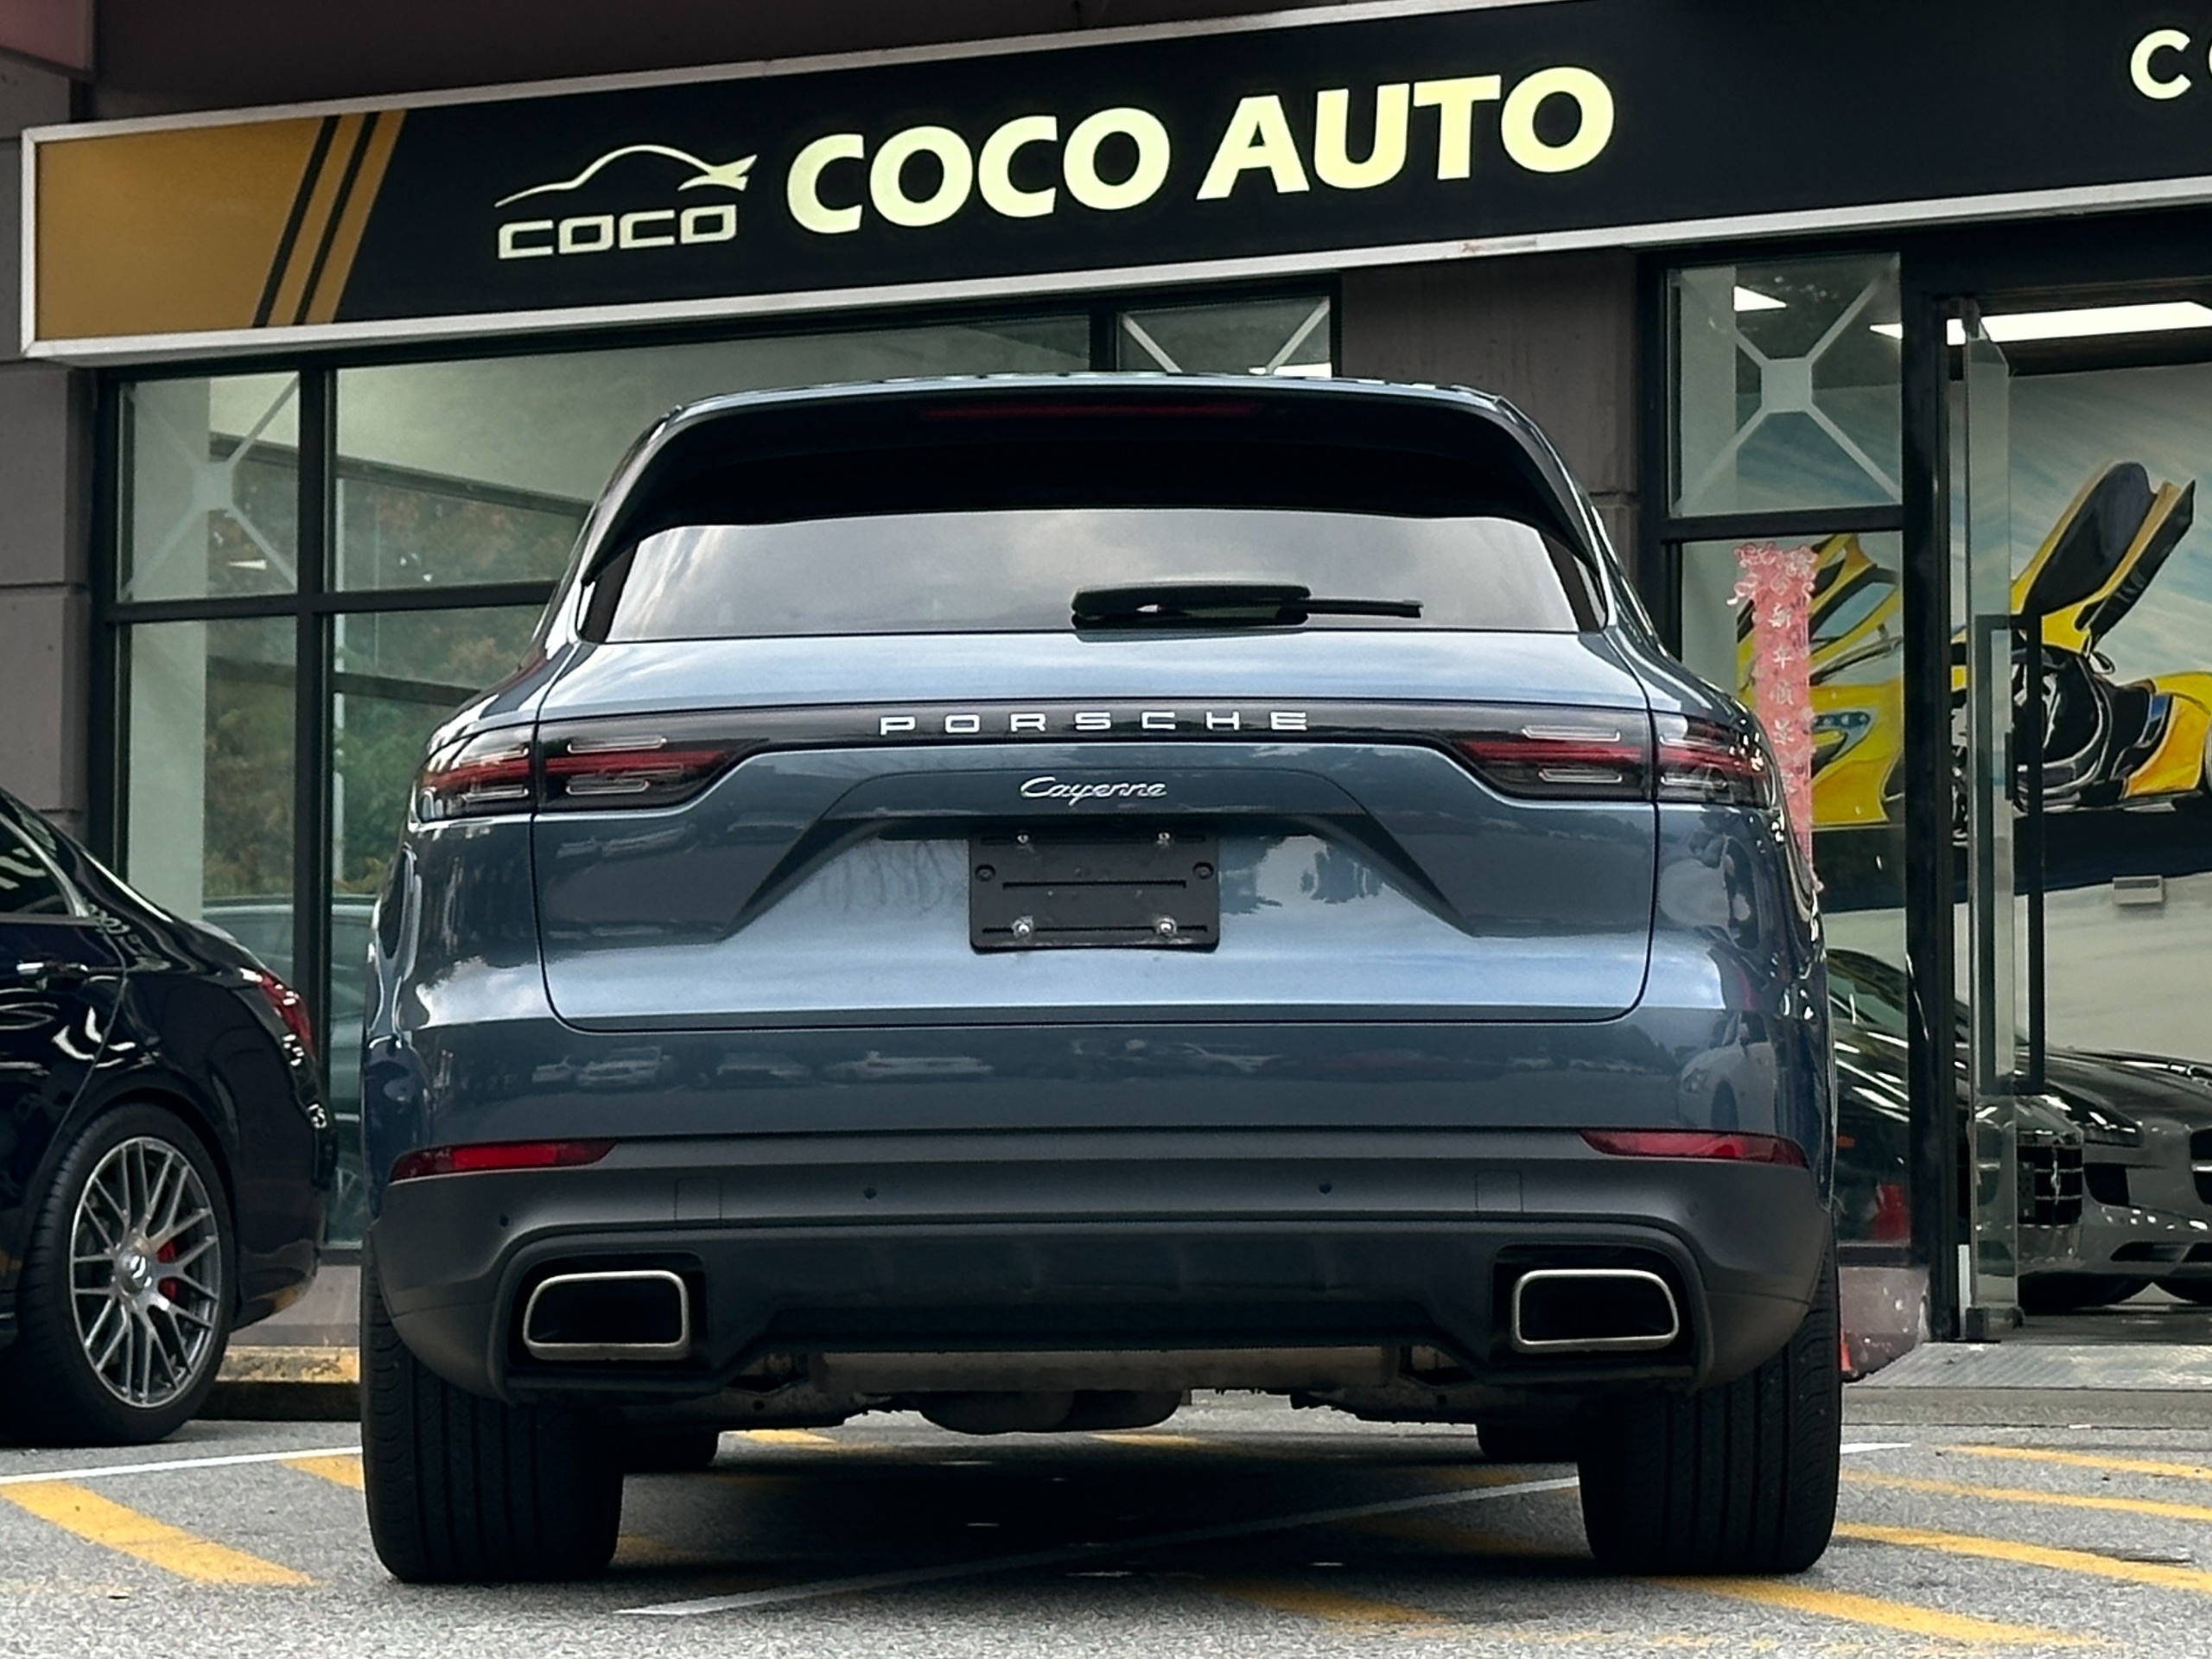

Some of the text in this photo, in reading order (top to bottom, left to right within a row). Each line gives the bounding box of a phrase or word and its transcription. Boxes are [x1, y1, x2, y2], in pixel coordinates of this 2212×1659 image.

[2130, 29, 2212, 99] C
[786, 67, 1615, 234] COCO AUTO
[498, 204, 737, 259] COCO
[880, 711, 1308, 735] PORSCHE
[1020, 776, 1167, 806] Cayenne
